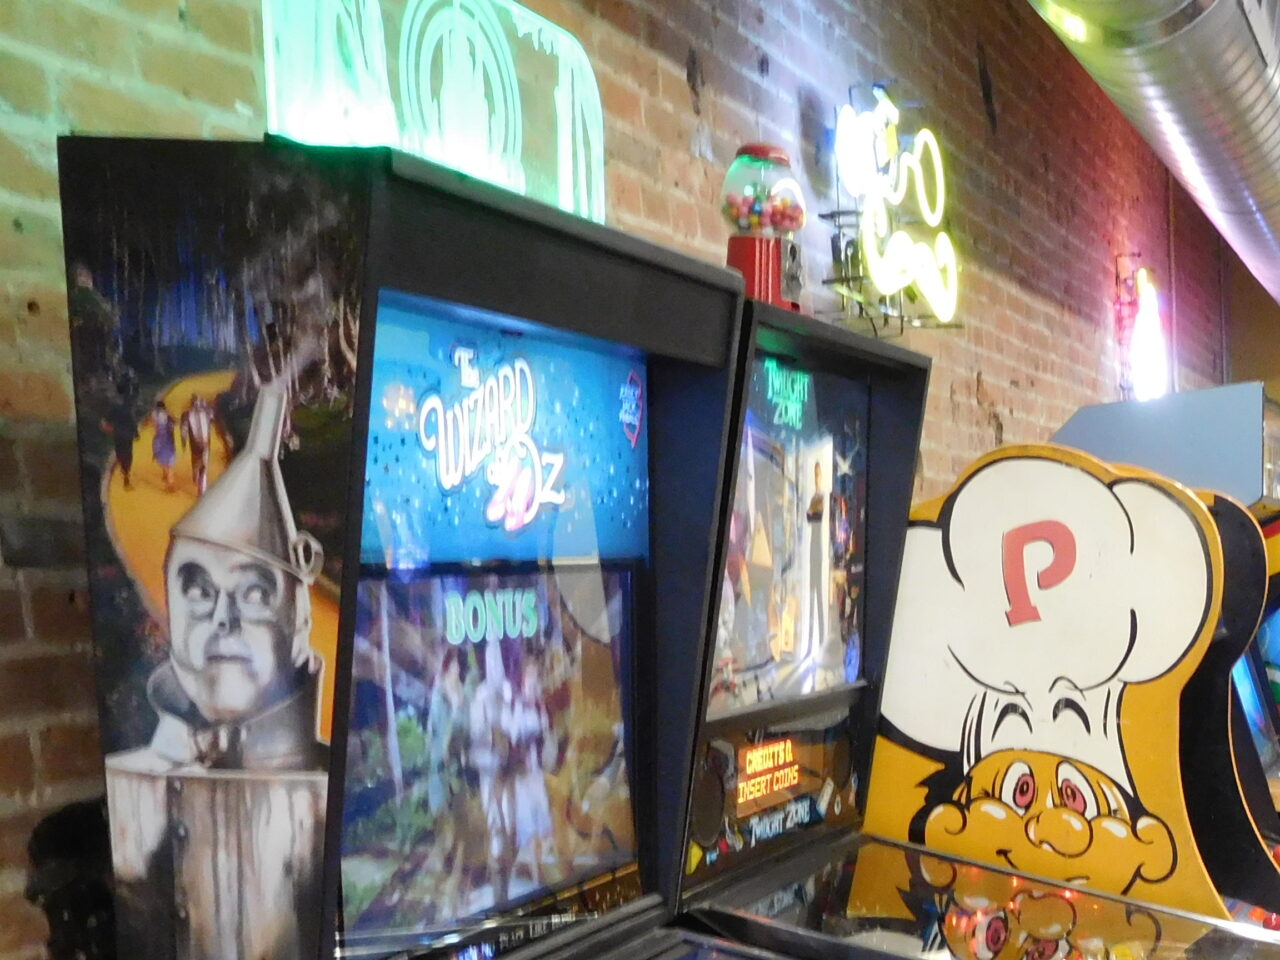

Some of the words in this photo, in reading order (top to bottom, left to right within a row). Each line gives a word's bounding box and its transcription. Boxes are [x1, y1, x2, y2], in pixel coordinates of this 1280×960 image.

[764, 357, 810, 403] TWILIGHT
[418, 357, 535, 491] WIZARD
[772, 397, 804, 431] ZONE
[1002, 519, 1077, 627] P
[445, 587, 539, 645] BONUS
[746, 741, 786, 775] CREDITS
[738, 775, 773, 804] INSERT
[773, 764, 799, 792] COINS
[749, 811, 785, 849] TWILIGHT
[785, 797, 811, 830] ZONE
